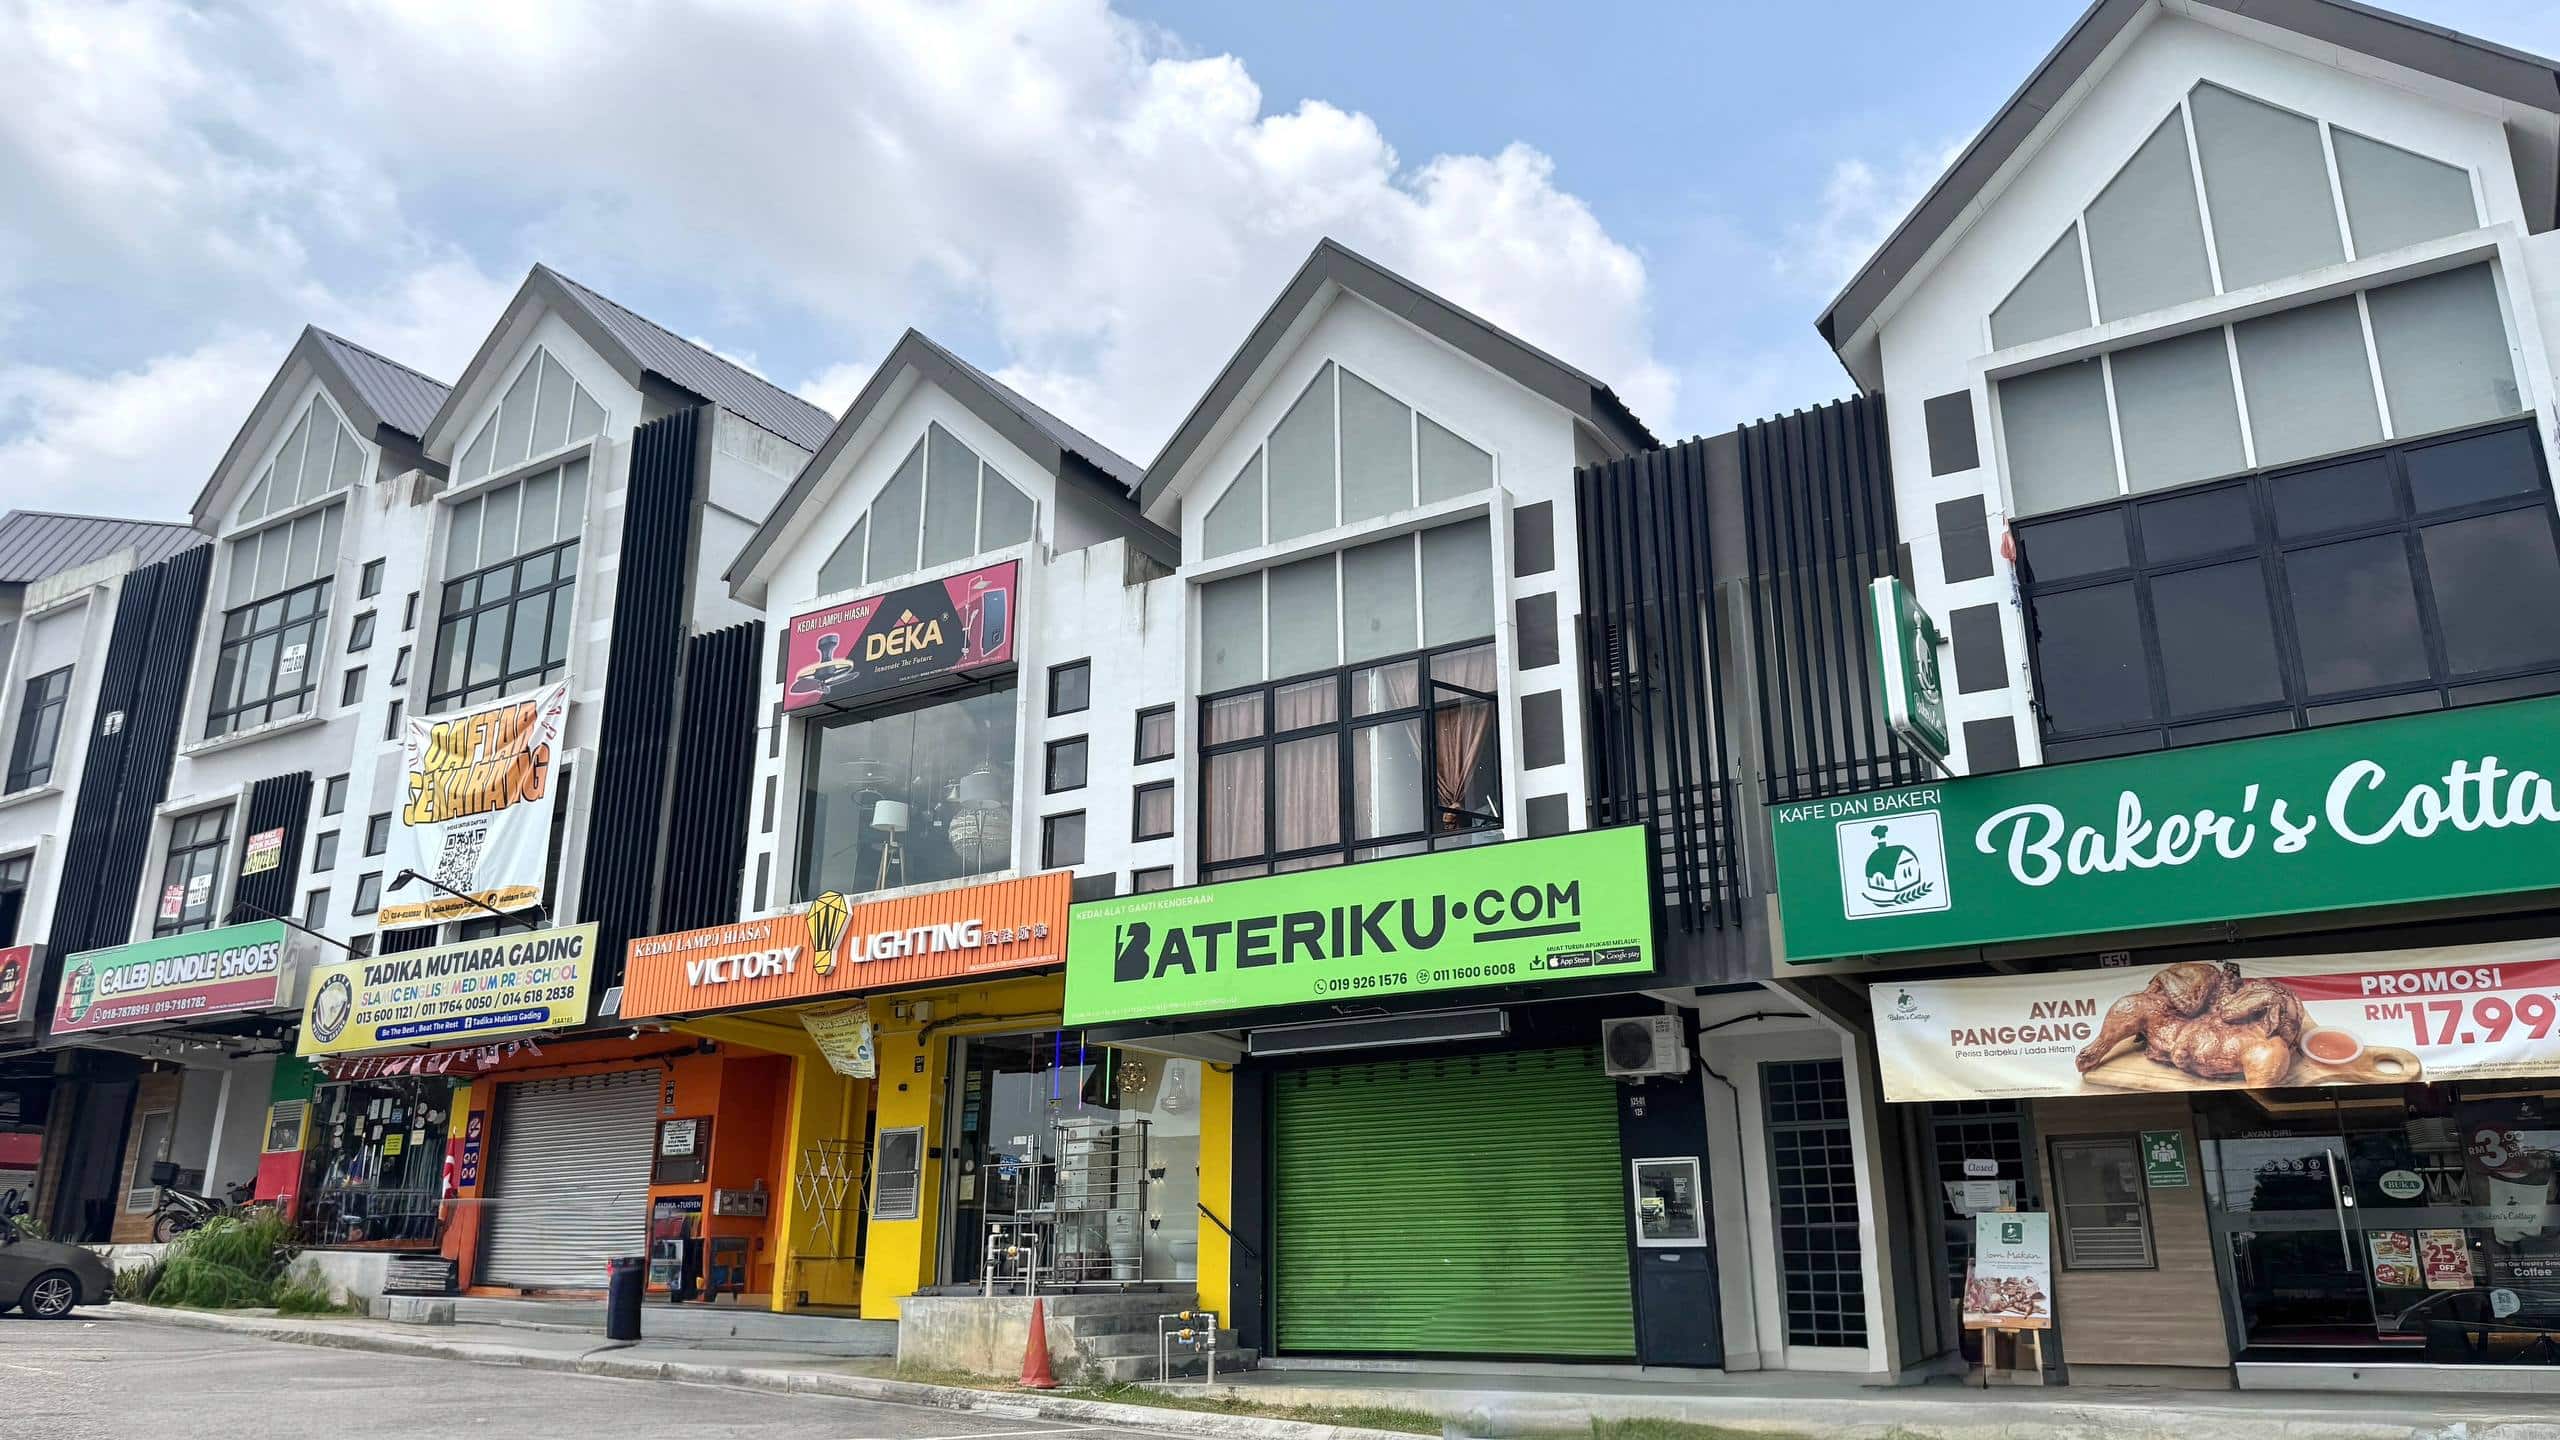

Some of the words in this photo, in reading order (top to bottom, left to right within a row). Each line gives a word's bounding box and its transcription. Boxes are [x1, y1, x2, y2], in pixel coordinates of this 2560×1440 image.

[797, 619, 817, 633] KEDAI
[819, 611, 843, 628] LAMPU
[844, 604, 870, 621] HIASAN
[866, 619, 944, 662] DEKA
[424, 700, 538, 774] DAFTAR
[403, 743, 550, 827] SEKARANG
[1779, 804, 1825, 823] KAFE
[1830, 799, 1868, 817] DAN
[1873, 789, 1941, 812] BAKERI
[1976, 783, 2316, 886] Baker's
[1076, 909, 1102, 921] KEDAI
[1104, 906, 1127, 917] ALAT
[1128, 903, 1156, 913] GANTI
[1157, 894, 1214, 909] KENDERAAN
[636, 941, 673, 957] KEDAI
[677, 932, 720, 952] LAMPU
[723, 925, 771, 945] HIASAN
[686, 945, 803, 987] VICTORY
[850, 918, 983, 964] LIGHTING
[100, 963, 149, 995] CALEB
[152, 952, 218, 986] BUNDLE
[221, 942, 280, 977] SHOES
[364, 956, 422, 986] TADIKA
[425, 945, 505, 976] MUTIARA
[508, 935, 583, 966] GADING
[1560, 958, 1573, 966] App
[1574, 956, 1590, 964] Store
[1606, 952, 1627, 961] Google
[403, 980, 450, 1001] ENGLISH
[451, 975, 498, 994] MEDIUM
[526, 964, 578, 986] SCHOOL
[1330, 977, 1350, 991] 019
[1352, 975, 1376, 988] 926
[1379, 972, 1407, 986] 1576
[1433, 969, 1450, 982] 011
[1453, 966, 1481, 979] 1600
[1483, 963, 1515, 976] 6008
[2360, 967, 2502, 996] PROMOSI
[356, 1010, 372, 1024] 013
[373, 1008, 394, 1023] 600
[395, 1006, 413, 1020] 1121
[421, 1003, 436, 1017] 011
[439, 1000, 463, 1015] 1764
[464, 997, 492, 1012] 0050
[502, 991, 522, 1007] 014
[523, 988, 543, 1003] 618
[545, 985, 575, 1001] 2838
[473, 1014, 493, 1026] Tadika
[519, 1010, 542, 1023] Gading
[2029, 998, 2097, 1019] AYAM
[1951, 1022, 2091, 1046] PANGGANG
[1984, 1047, 2018, 1057] Barbeku
[2025, 1046, 2046, 1055] Lada
[2049, 1044, 2076, 1055] Hitam)
[2242, 1130, 2271, 1138] LAYAN
[1968, 1163, 1994, 1173] Closed
[2388, 1181, 2415, 1189] BUKA
[2007, 1249, 2040, 1260] Makan
[2514, 1267, 2552, 1277] Coffee
